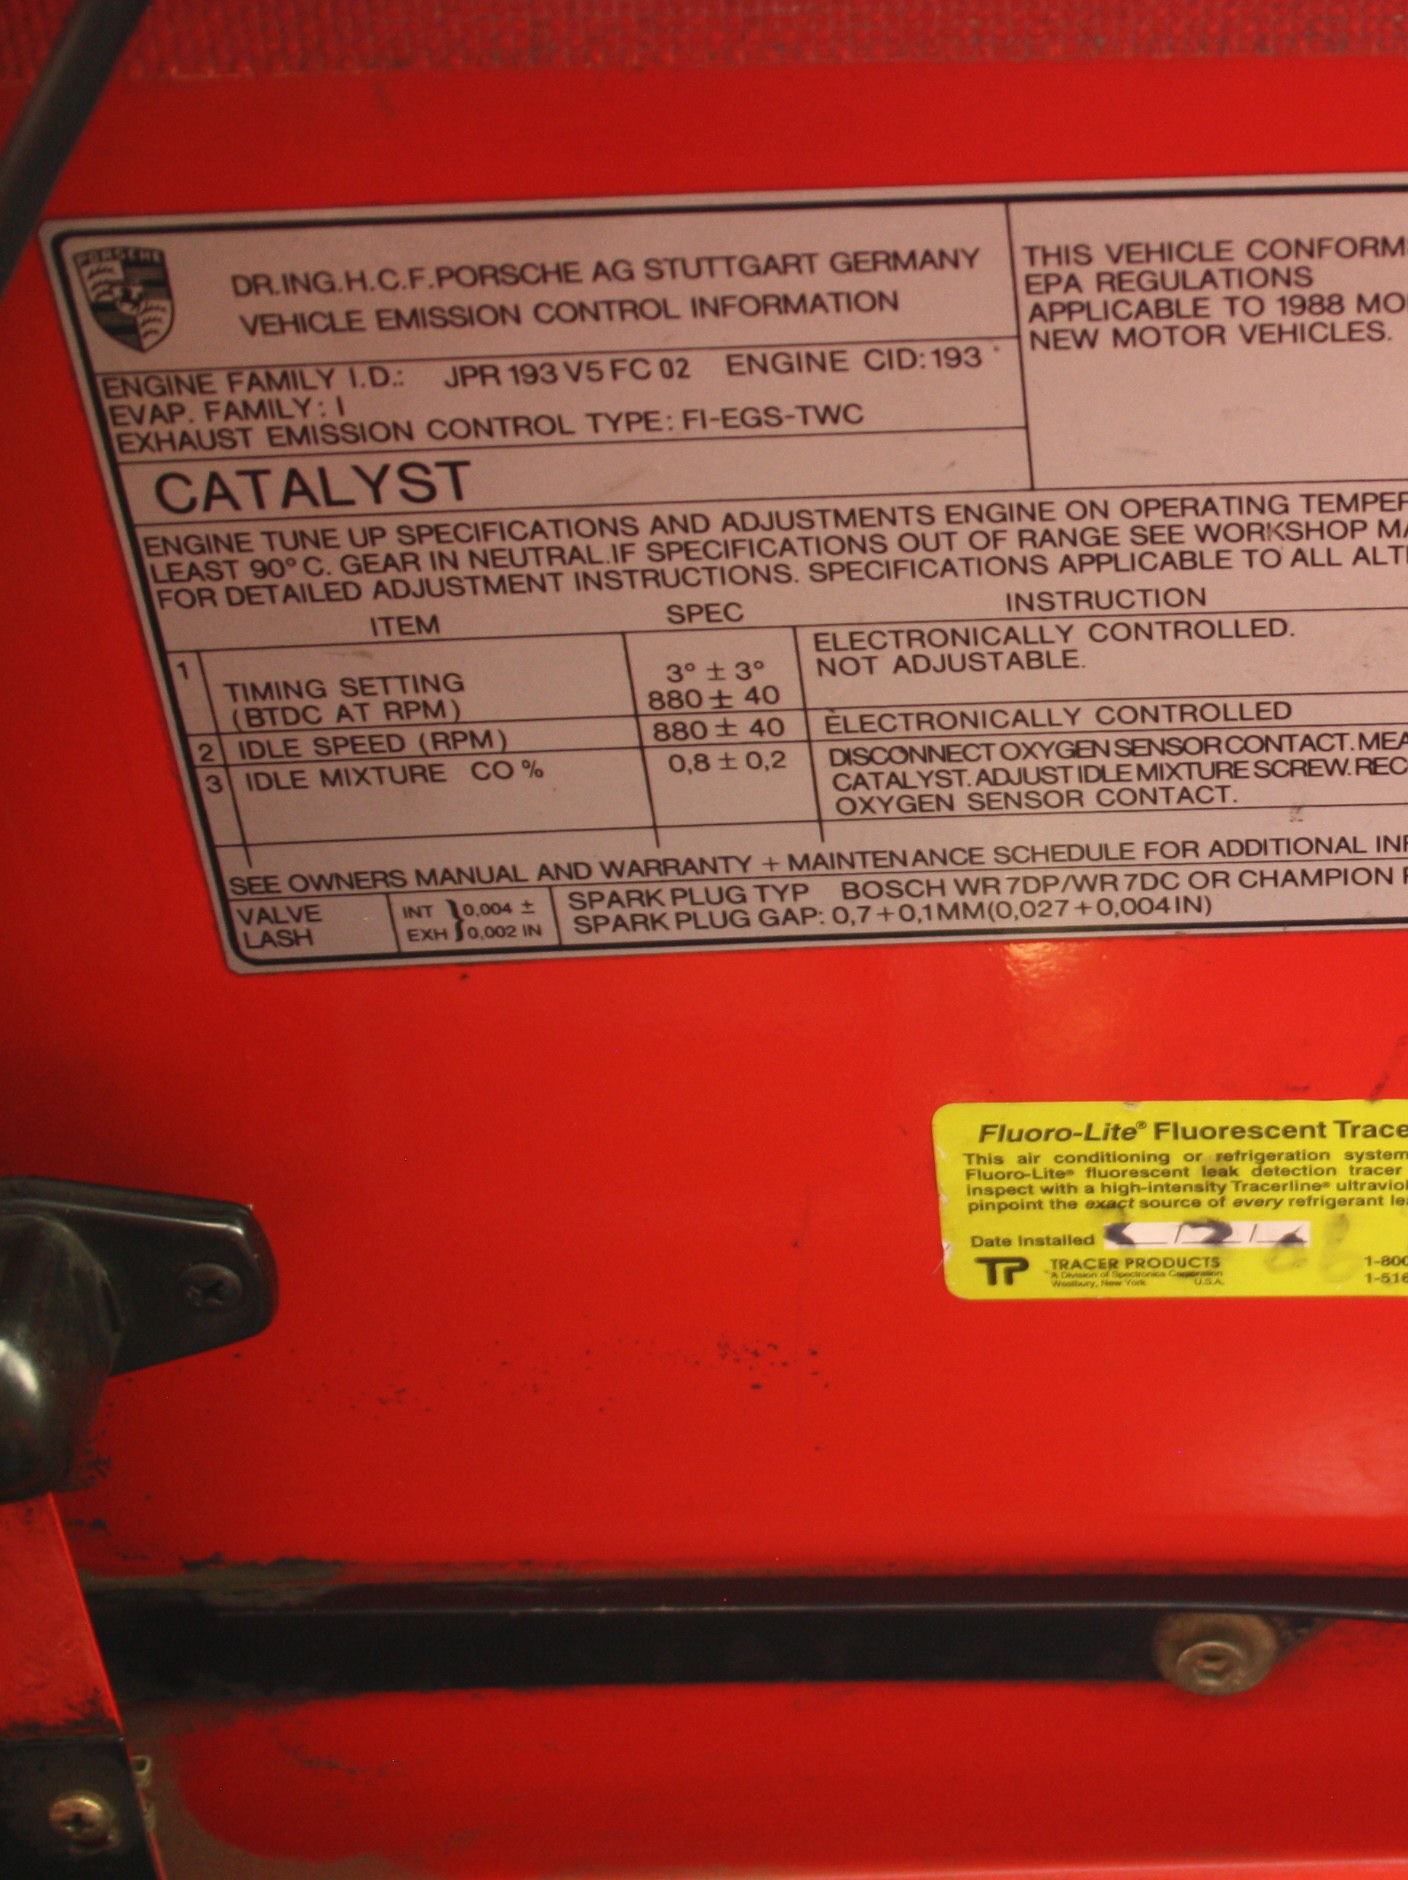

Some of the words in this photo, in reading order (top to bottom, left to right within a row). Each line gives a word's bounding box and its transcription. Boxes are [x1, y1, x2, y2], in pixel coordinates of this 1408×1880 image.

[591, 258, 636, 283] AG
[643, 252, 820, 282] STUTTGART
[829, 247, 980, 275] GERMANY
[1021, 243, 1094, 268] THIS
[1104, 239, 1235, 265] VEHICLE
[1024, 272, 1084, 296] EPA
[1095, 265, 1315, 294] REGULATIONS
[238, 309, 367, 337] VEHICLE
[374, 303, 523, 332] EMISSION
[532, 297, 682, 326] CONTROL
[690, 289, 900, 319] INFORMATION
[1027, 296, 1211, 324] APPLICABLE
[1222, 295, 1266, 318] TO
[1276, 292, 1346, 317] 1988
[1029, 327, 1100, 352] NEW
[1111, 323, 1227, 349] MOTOR
[1238, 319, 1392, 345] VEHICLES.
[725, 349, 850, 377] ENGINE
[103, 374, 215, 399] ENGINE
[228, 367, 336, 393] FAMILY
[108, 401, 195, 428] EVAP.
[115, 426, 254, 455] EXHAUST
[265, 419, 415, 448] EMISSION
[426, 414, 577, 442] CONTROL
[154, 459, 472, 516] CATALYST
[142, 531, 255, 558] ENGINE
[259, 527, 342, 553] TUNE
[347, 525, 388, 549] UP
[395, 515, 641, 547] SPECIFICATIONS
[649, 512, 711, 536] AND
[720, 504, 936, 534] ADJUSTMENTS
[944, 500, 1057, 526] ENGINE
[1065, 499, 1110, 522] ON
[1119, 493, 1290, 520] OPERATING
[666, 601, 745, 625] SPEC
[1005, 586, 1207, 613] INSTRUCTION
[369, 613, 441, 638] ITEM
[813, 623, 1074, 653] ELECTRONICALLY
[1088, 617, 1295, 644] CONTROLLED.
[816, 655, 879, 678] NOT
[892, 648, 1086, 675] ADJUSTABLE.
[222, 678, 328, 704] TIMING
[338, 672, 465, 698] SETTING
[647, 688, 704, 712] 880
[743, 684, 781, 706] 40
[335, 701, 371, 724] AT
[238, 737, 303, 761] IDLE
[312, 733, 407, 758] SPEED
[244, 769, 310, 792] IDLE
[318, 762, 448, 788] MIXTURE
[567, 888, 667, 911] SPARK
[669, 884, 748, 907] PLUG
[752, 882, 810, 904] TYP
[840, 878, 947, 901] BOSCH
[1237, 866, 1394, 889] CHAMPION
[236, 903, 324, 927] VALVE
[402, 904, 433, 919] INT
[242, 927, 315, 950] LASH
[406, 928, 449, 943] EXH
[1153, 1120, 1328, 1141] Fluorescent
[962, 1152, 1005, 1166] This
[1016, 1152, 1041, 1165] air
[1053, 1150, 1171, 1166] conditioning
[1182, 1152, 1204, 1163] or
[1215, 1148, 1331, 1163] refrigeration
[1084, 1166, 1190, 1179] fluorescent
[1200, 1164, 1240, 1179] leak
[1251, 1164, 1337, 1178] detection
[1348, 1164, 1403, 1177] tracer
[966, 1183, 1035, 1199] inspect
[1039, 1182, 1079, 1195] with
[1100, 1179, 1228, 1197] high-intensity
[967, 1198, 1045, 1215] pinpoint
[1049, 1197, 1079, 1211] the
[1084, 1197, 1136, 1213] exact
[1138, 1198, 1203, 1209] source
[1207, 1194, 1227, 1209] of
[1232, 1197, 1284, 1211] every
[1288, 1194, 1385, 1211] refrigerant
[970, 1234, 1013, 1249] Date
[1017, 1233, 1096, 1247] Installed
[1050, 1257, 1121, 1270] TRACER
[1124, 1255, 1222, 1270] PRODUCTS
[1126, 1278, 1145, 1286] York
